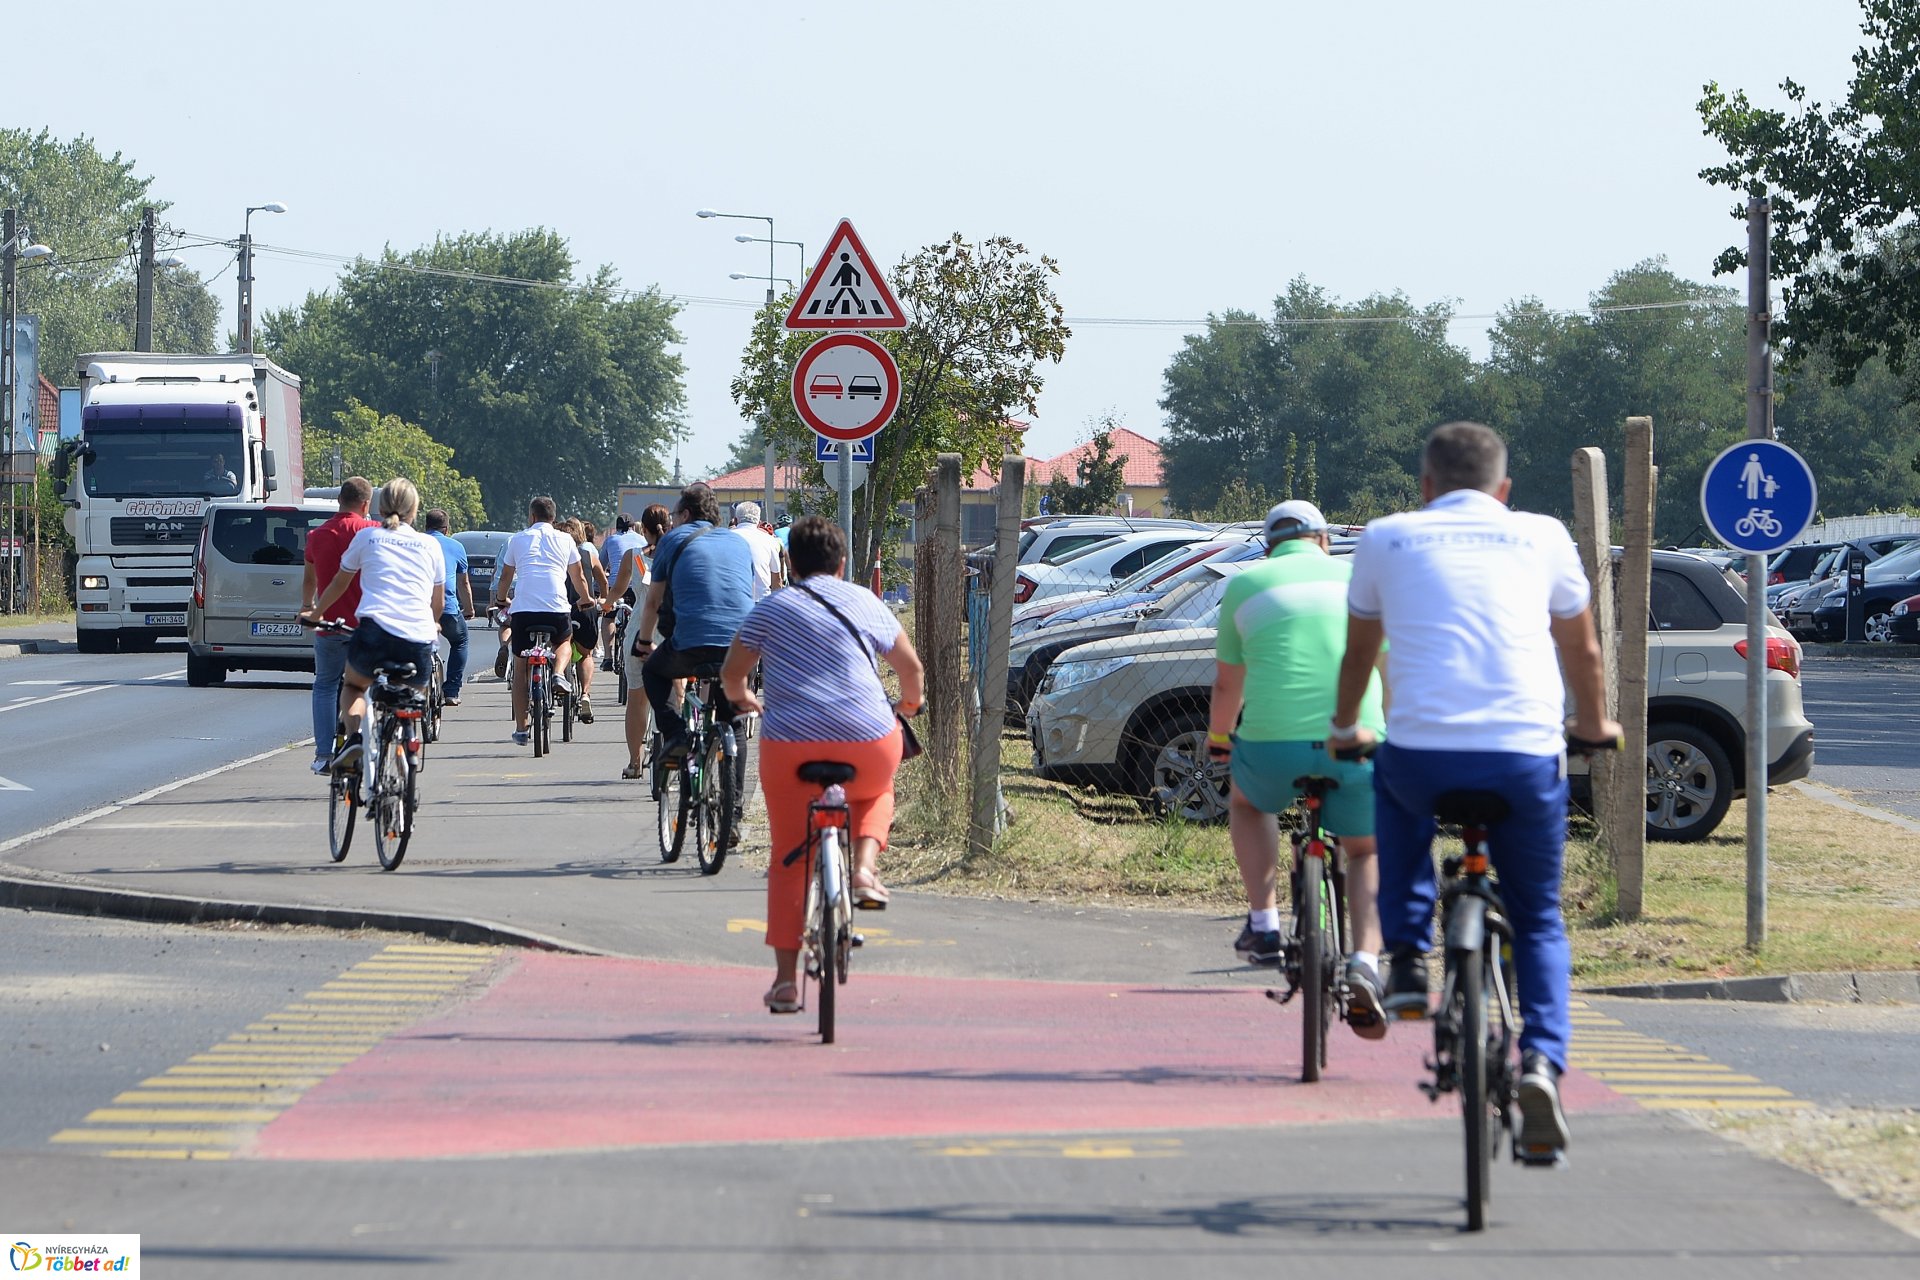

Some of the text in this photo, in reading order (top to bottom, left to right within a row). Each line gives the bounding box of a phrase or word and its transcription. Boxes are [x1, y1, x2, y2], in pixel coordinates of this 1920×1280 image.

[126, 501, 202, 516] Görömbei
[144, 522, 182, 531] MAN
[258, 624, 300, 634] PGZ-872
